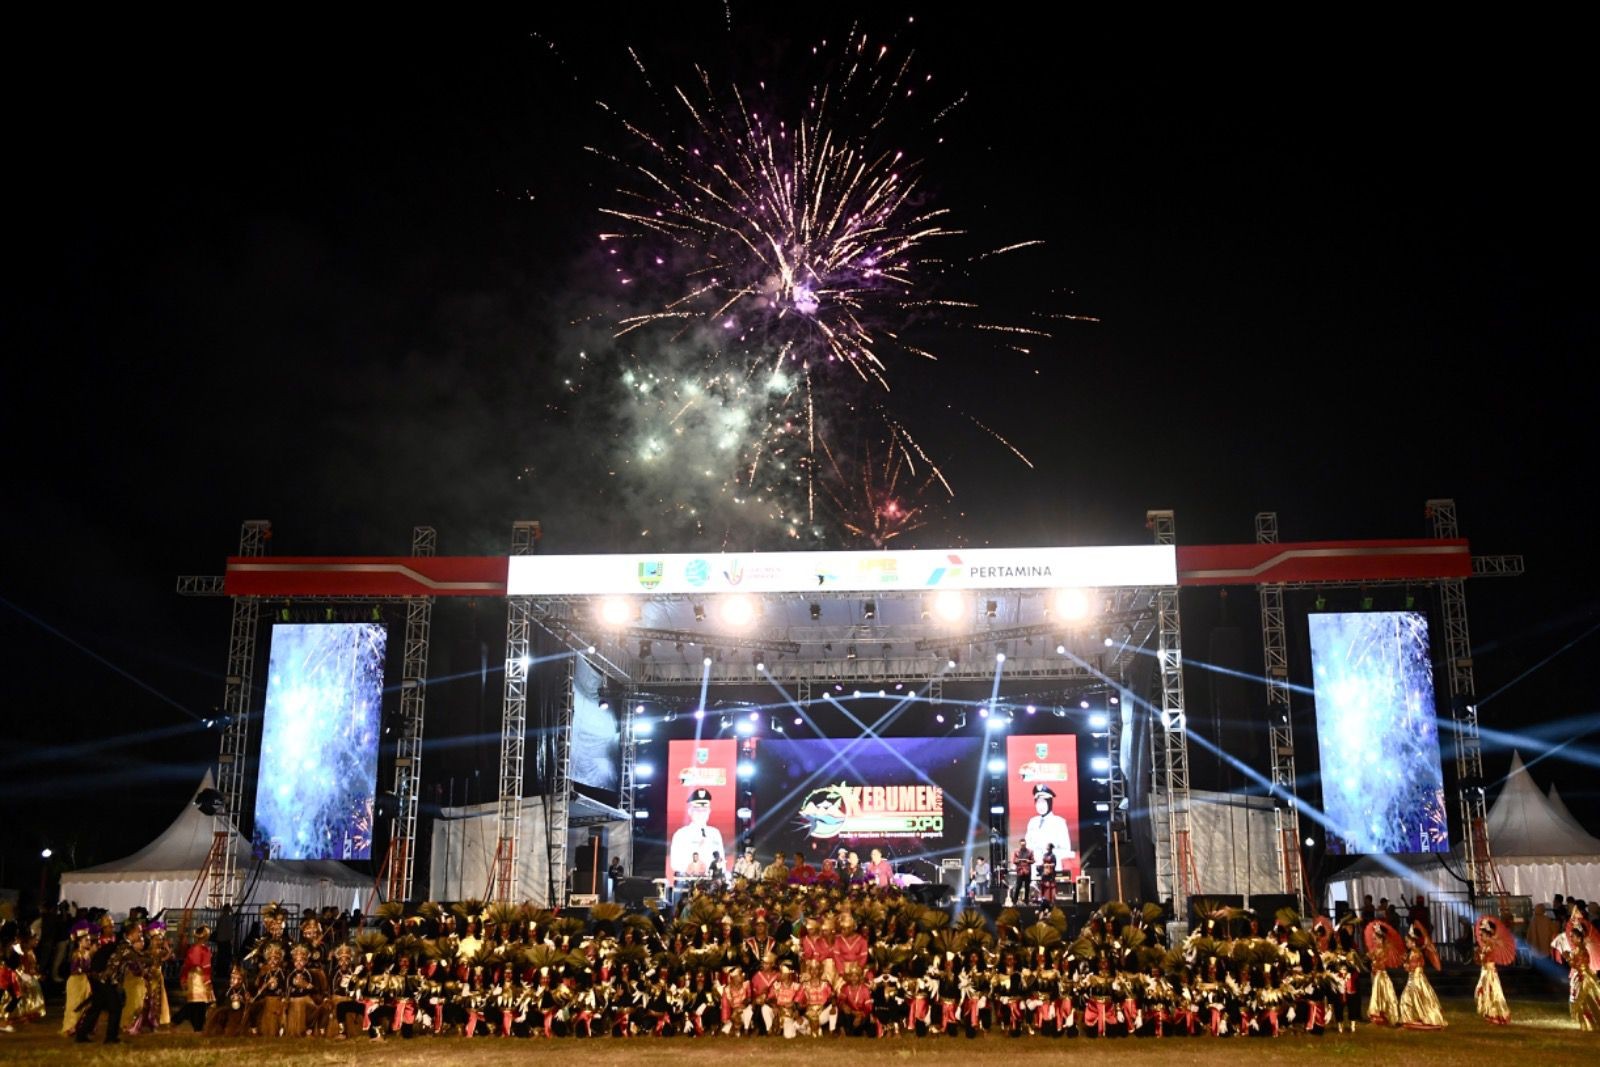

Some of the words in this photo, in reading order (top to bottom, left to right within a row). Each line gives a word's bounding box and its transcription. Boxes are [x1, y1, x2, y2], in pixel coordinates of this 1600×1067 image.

[970, 565, 1052, 578] PERTAMINA
[848, 786, 936, 815] KEBUMEN
[905, 816, 944, 831] EXPO
